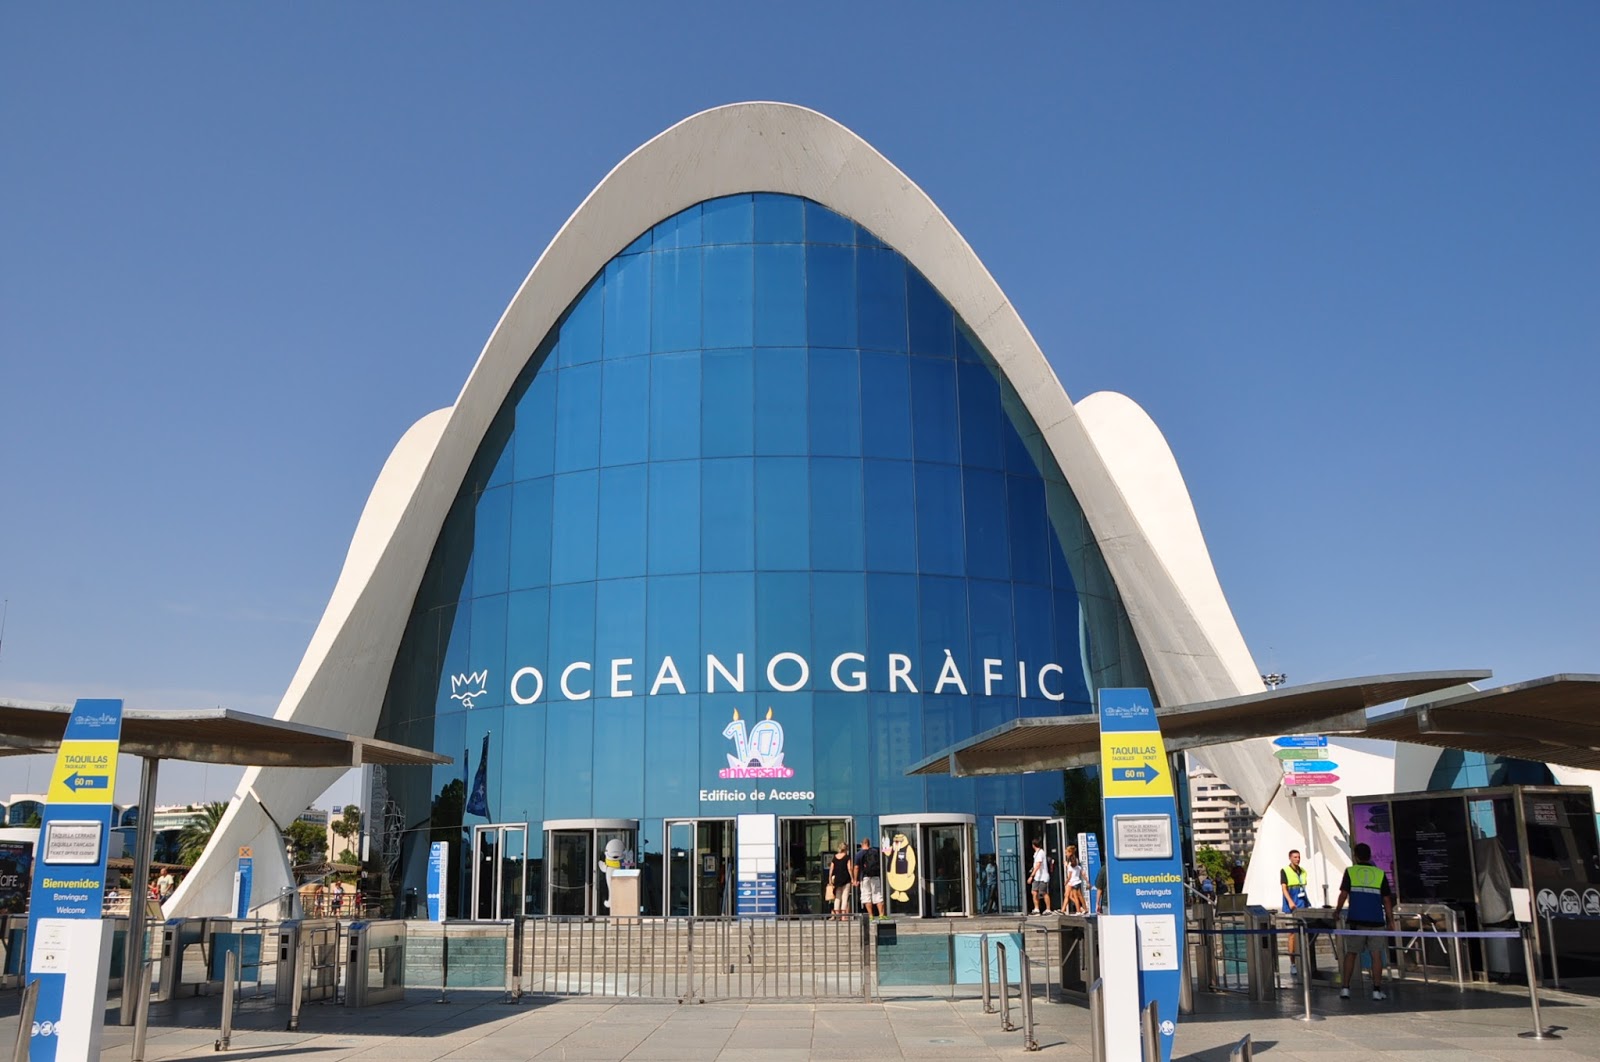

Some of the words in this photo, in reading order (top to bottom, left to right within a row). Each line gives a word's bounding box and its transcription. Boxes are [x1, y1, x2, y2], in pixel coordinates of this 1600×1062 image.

[510, 649, 1065, 705] OCEANOGRÀFIC
[722, 719, 784, 765] 10
[1110, 746, 1157, 755] TAQUILLAS
[65, 755, 109, 764] TAQUILLAS
[719, 766, 796, 779] aniversario
[1125, 769, 1135, 778] 60
[74, 777, 85, 786] 60
[699, 789, 747, 802] Edificio
[749, 789, 766, 801] de
[768, 788, 815, 801] Acceso
[0, 875, 18, 888] CIFE
[42, 878, 100, 889] Bienvenidos
[1122, 873, 1182, 884] Bienvenidos
[53, 893, 88, 902] Benvinguts
[1136, 888, 1172, 897] Benvinguts
